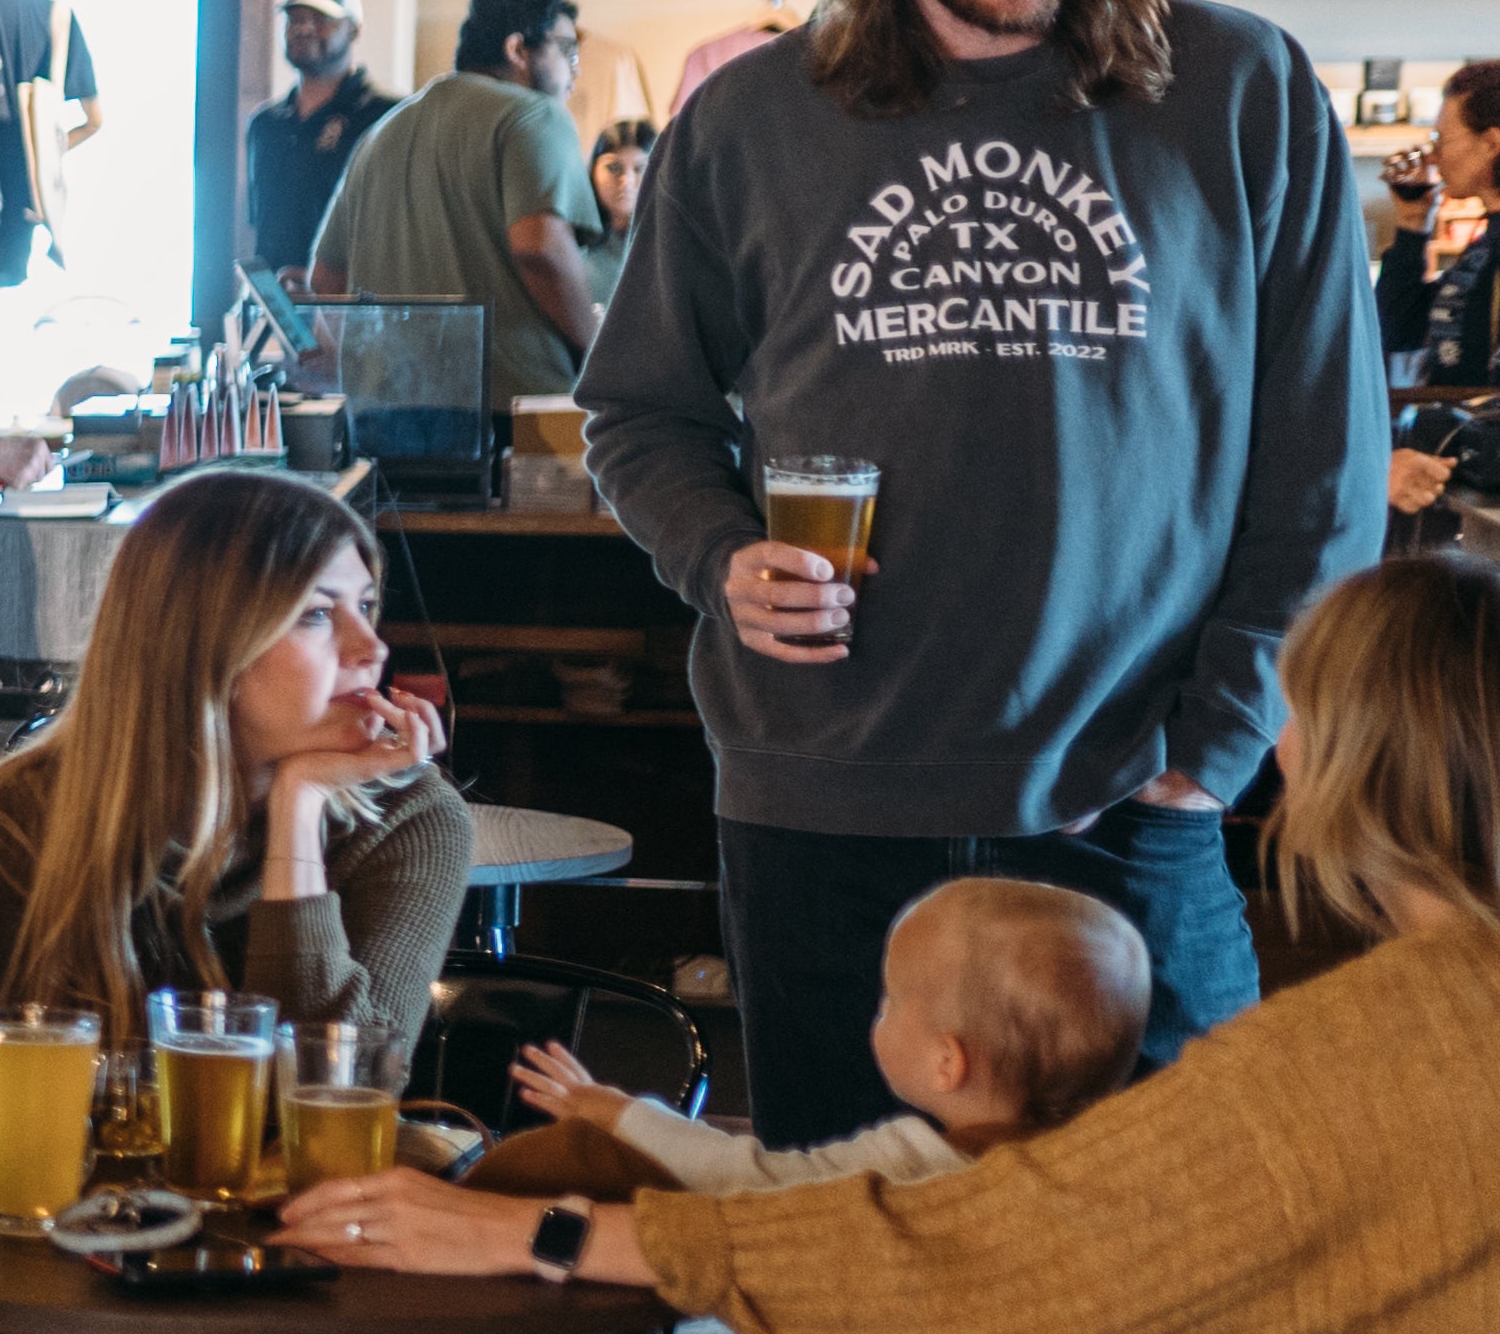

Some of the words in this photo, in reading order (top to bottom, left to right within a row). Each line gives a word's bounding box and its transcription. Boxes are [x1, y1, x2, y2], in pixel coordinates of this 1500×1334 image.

[831, 184, 915, 298] SAD
[919, 141, 1150, 294] MONKEY
[892, 194, 969, 262] PALO
[984, 191, 1078, 253] DURO
[949, 221, 1020, 251] TX
[890, 260, 1081, 291] CANYON
[835, 297, 1148, 345] MERCANTILE
[883, 347, 926, 363] TRD
[928, 341, 980, 357] MRK
[996, 342, 1041, 357] EST.
[1048, 342, 1107, 361] 2022
